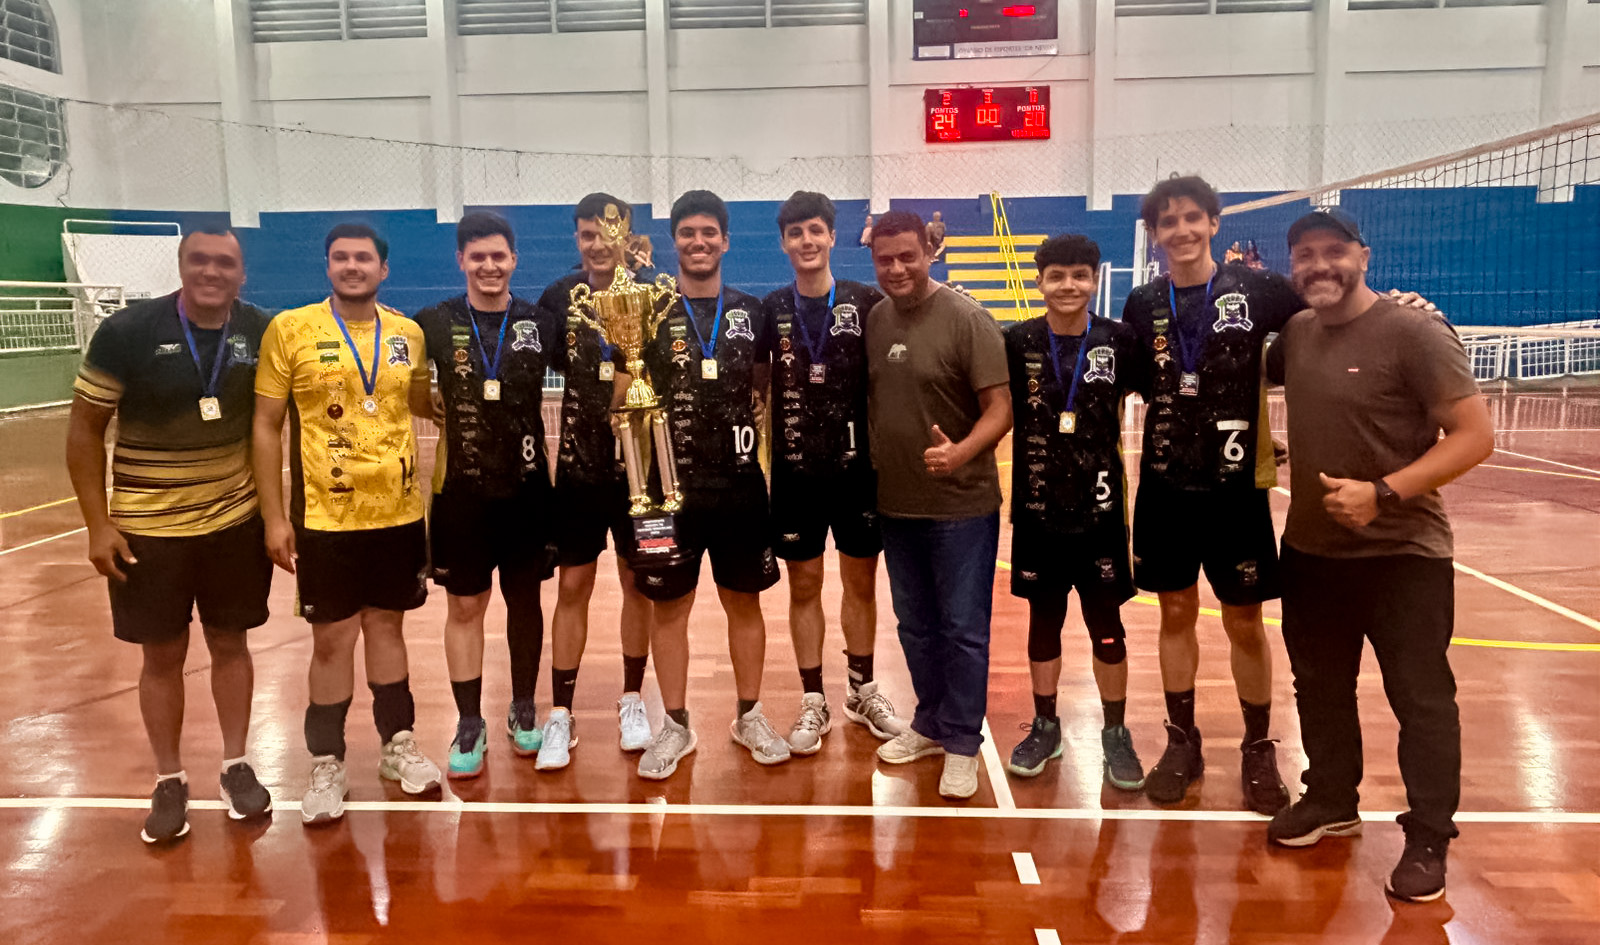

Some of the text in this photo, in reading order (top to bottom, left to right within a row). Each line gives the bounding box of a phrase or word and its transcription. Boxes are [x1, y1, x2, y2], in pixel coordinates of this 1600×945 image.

[930, 107, 959, 115] PONTOS
[934, 114, 955, 130] 24
[1016, 104, 1046, 112] PONTOS
[1024, 111, 1045, 127] 20
[522, 434, 536, 462] 8
[732, 425, 754, 454] 10
[847, 421, 856, 449] 1
[1223, 430, 1245, 462] 6
[1095, 470, 1111, 501] 5
